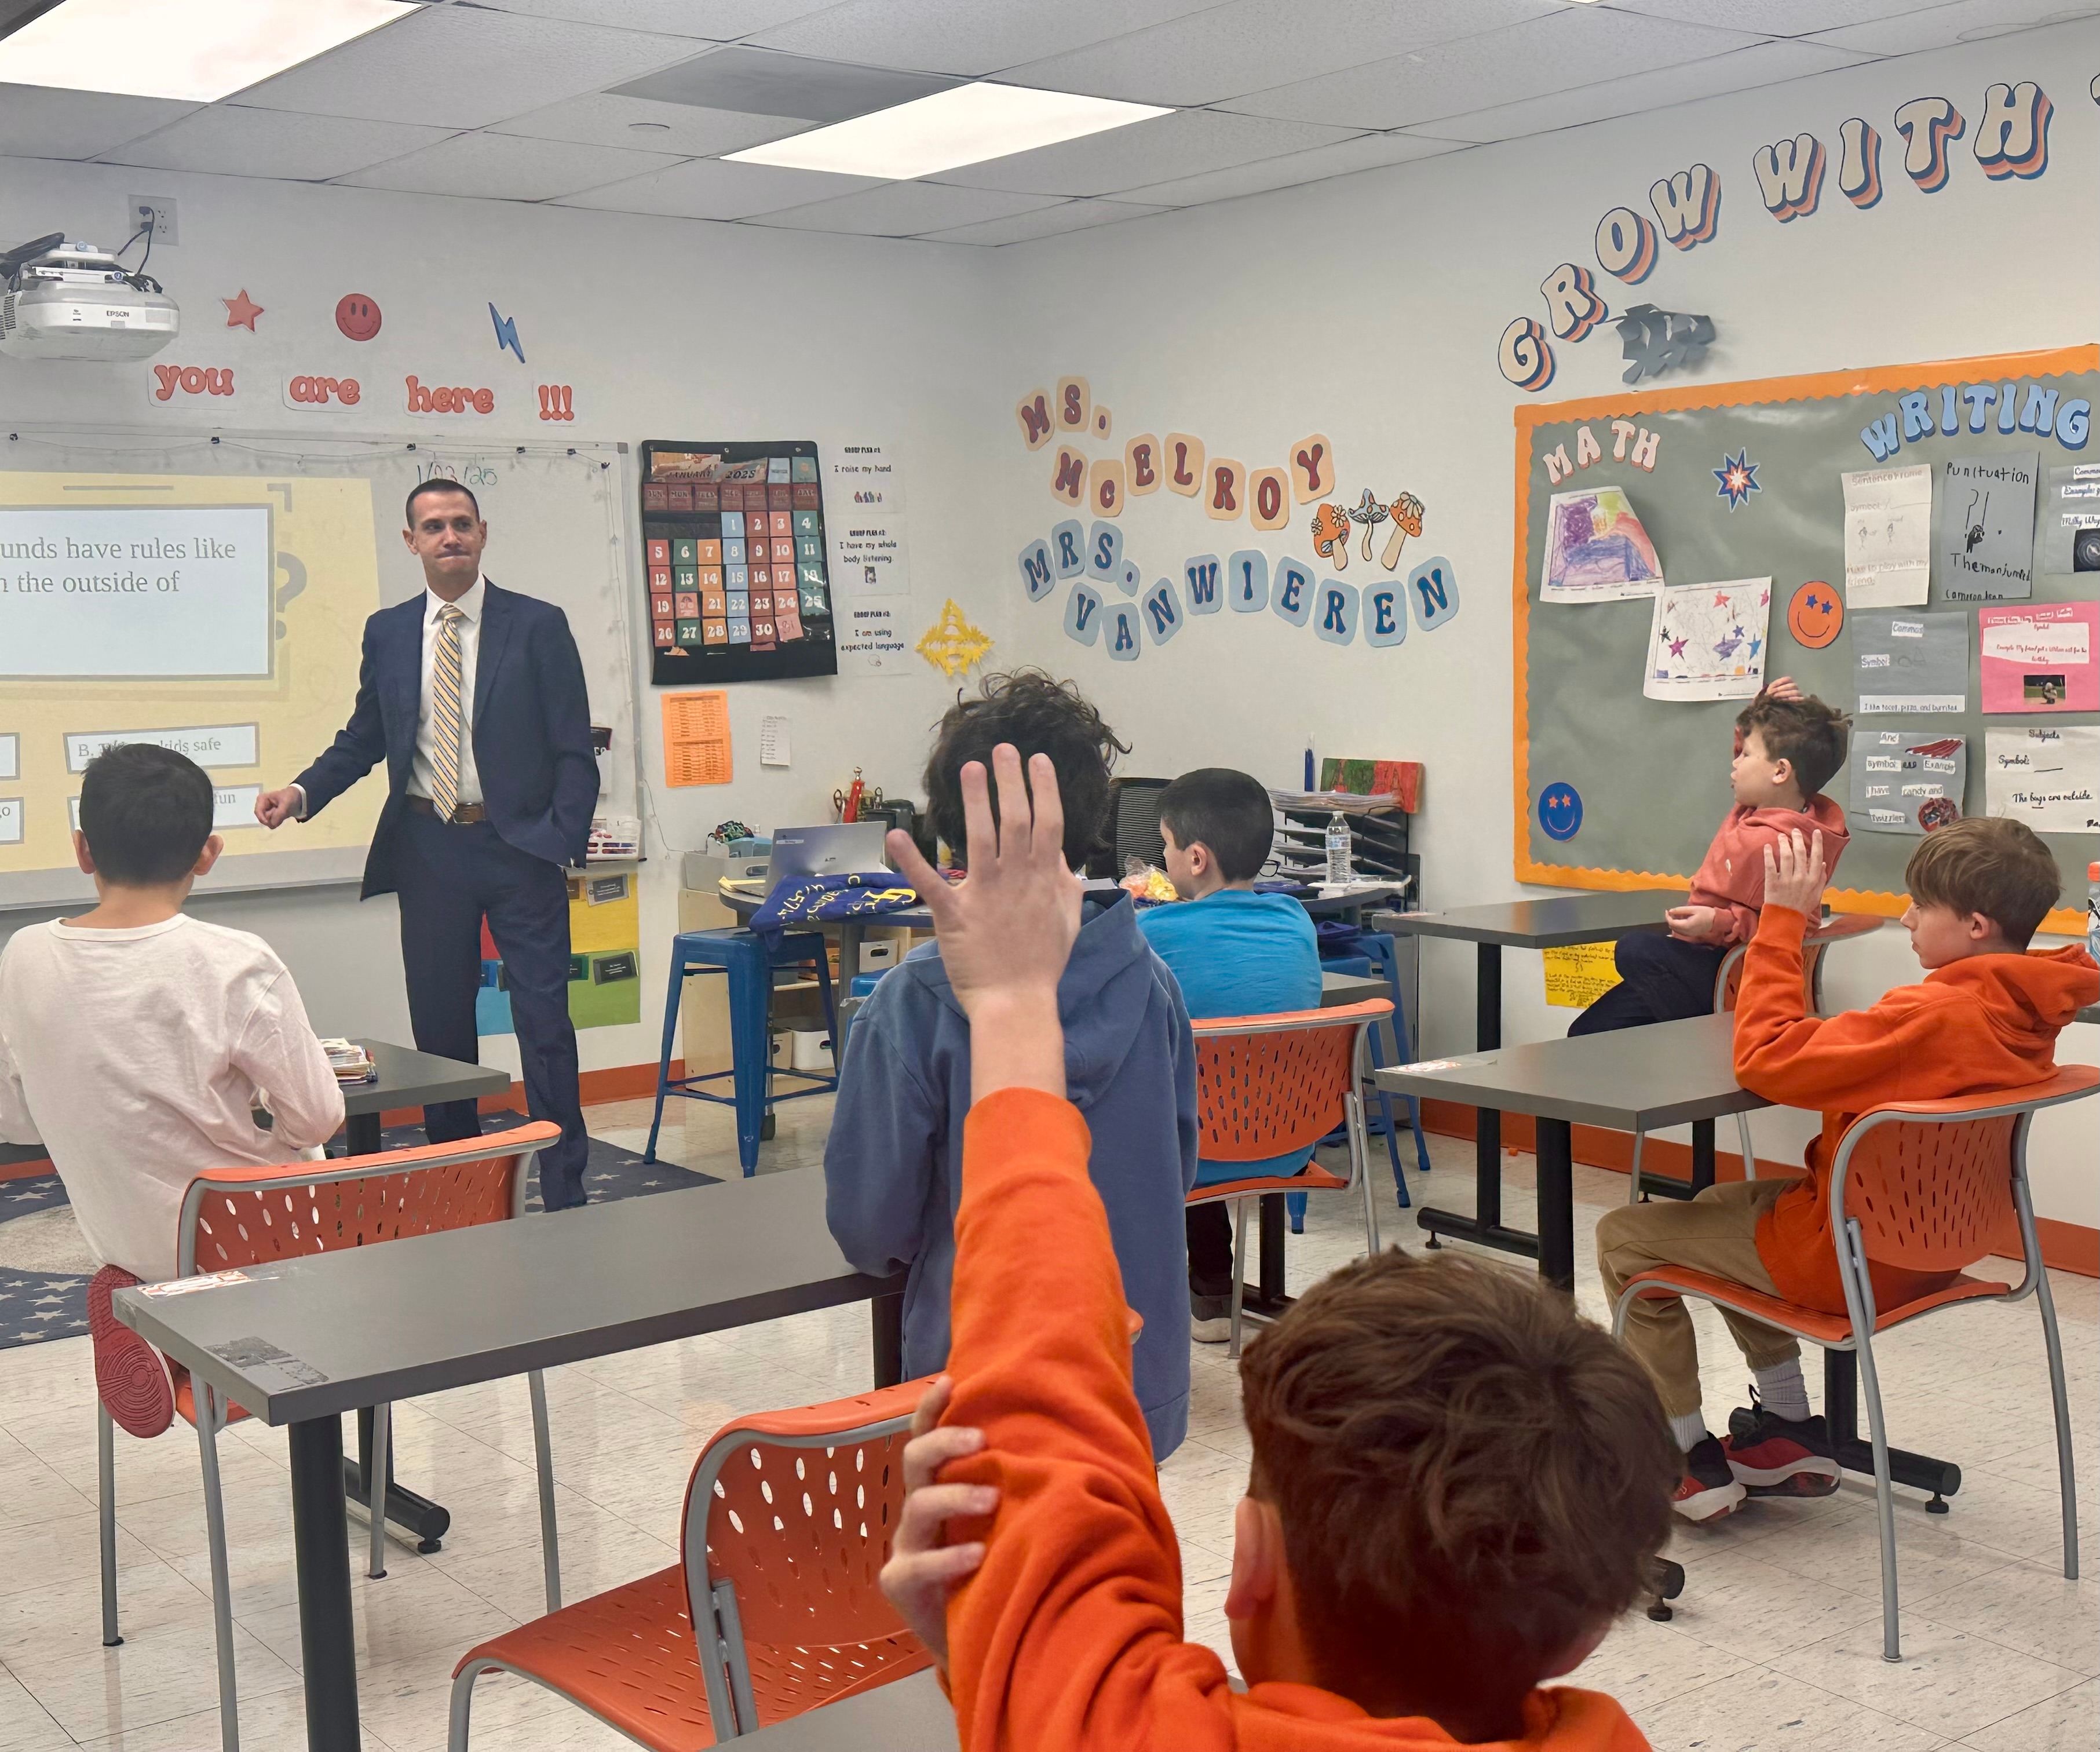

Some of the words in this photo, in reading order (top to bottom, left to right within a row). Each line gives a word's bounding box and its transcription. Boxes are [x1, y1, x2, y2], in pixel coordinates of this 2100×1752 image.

[1498, 163, 1721, 392] GROW
[1753, 81, 2054, 223] WITH
[154, 365, 233, 400] you
[290, 375, 360, 404] are
[406, 375, 494, 414] here
[538, 385, 574, 421] !!!
[1021, 385, 1106, 443] MS.
[1860, 384, 2091, 463] WRITING
[1543, 420, 1660, 486] MATH
[725, 469, 755, 479] 2025
[731, 520, 735, 530] 1
[754, 519, 761, 530] 2
[777, 519, 784, 528] 3
[802, 518, 810, 528] 4
[67, 537, 122, 559] have
[131, 538, 186, 559] rules
[195, 538, 236, 559] like
[655, 546, 663, 558] 5
[681, 546, 689, 557] 6
[706, 546, 713, 557] 7
[731, 546, 738, 557] 8
[755, 545, 762, 556] 9
[776, 544, 790, 556] 10
[805, 544, 815, 555] 11
[843, 555, 860, 564] body
[1024, 531, 1133, 592] MRS.
[17, 572, 53, 592] the
[63, 572, 148, 592] outside
[157, 571, 180, 592] of
[655, 574, 667, 585] 12
[681, 573, 693, 585] 13
[703, 572, 717, 584] 14
[732, 572, 743, 583] 15
[754, 571, 766, 582] 16
[778, 571, 790, 581] 17
[708, 598, 721, 609] 21
[731, 599, 746, 610] 22
[754, 598, 770, 609] 23
[778, 597, 796, 608] 24
[805, 596, 821, 607] 25
[1077, 561, 1447, 652] VANWIEREN
[682, 627, 696, 638] 27
[733, 626, 748, 636] 29
[755, 624, 773, 635] 30
[875, 629, 892, 637] using
[841, 643, 872, 652] expected
[78, 744, 93, 756] B.
[193, 738, 221, 750] safe
[214, 792, 236, 804] fun
[2013, 793, 2027, 802] The
